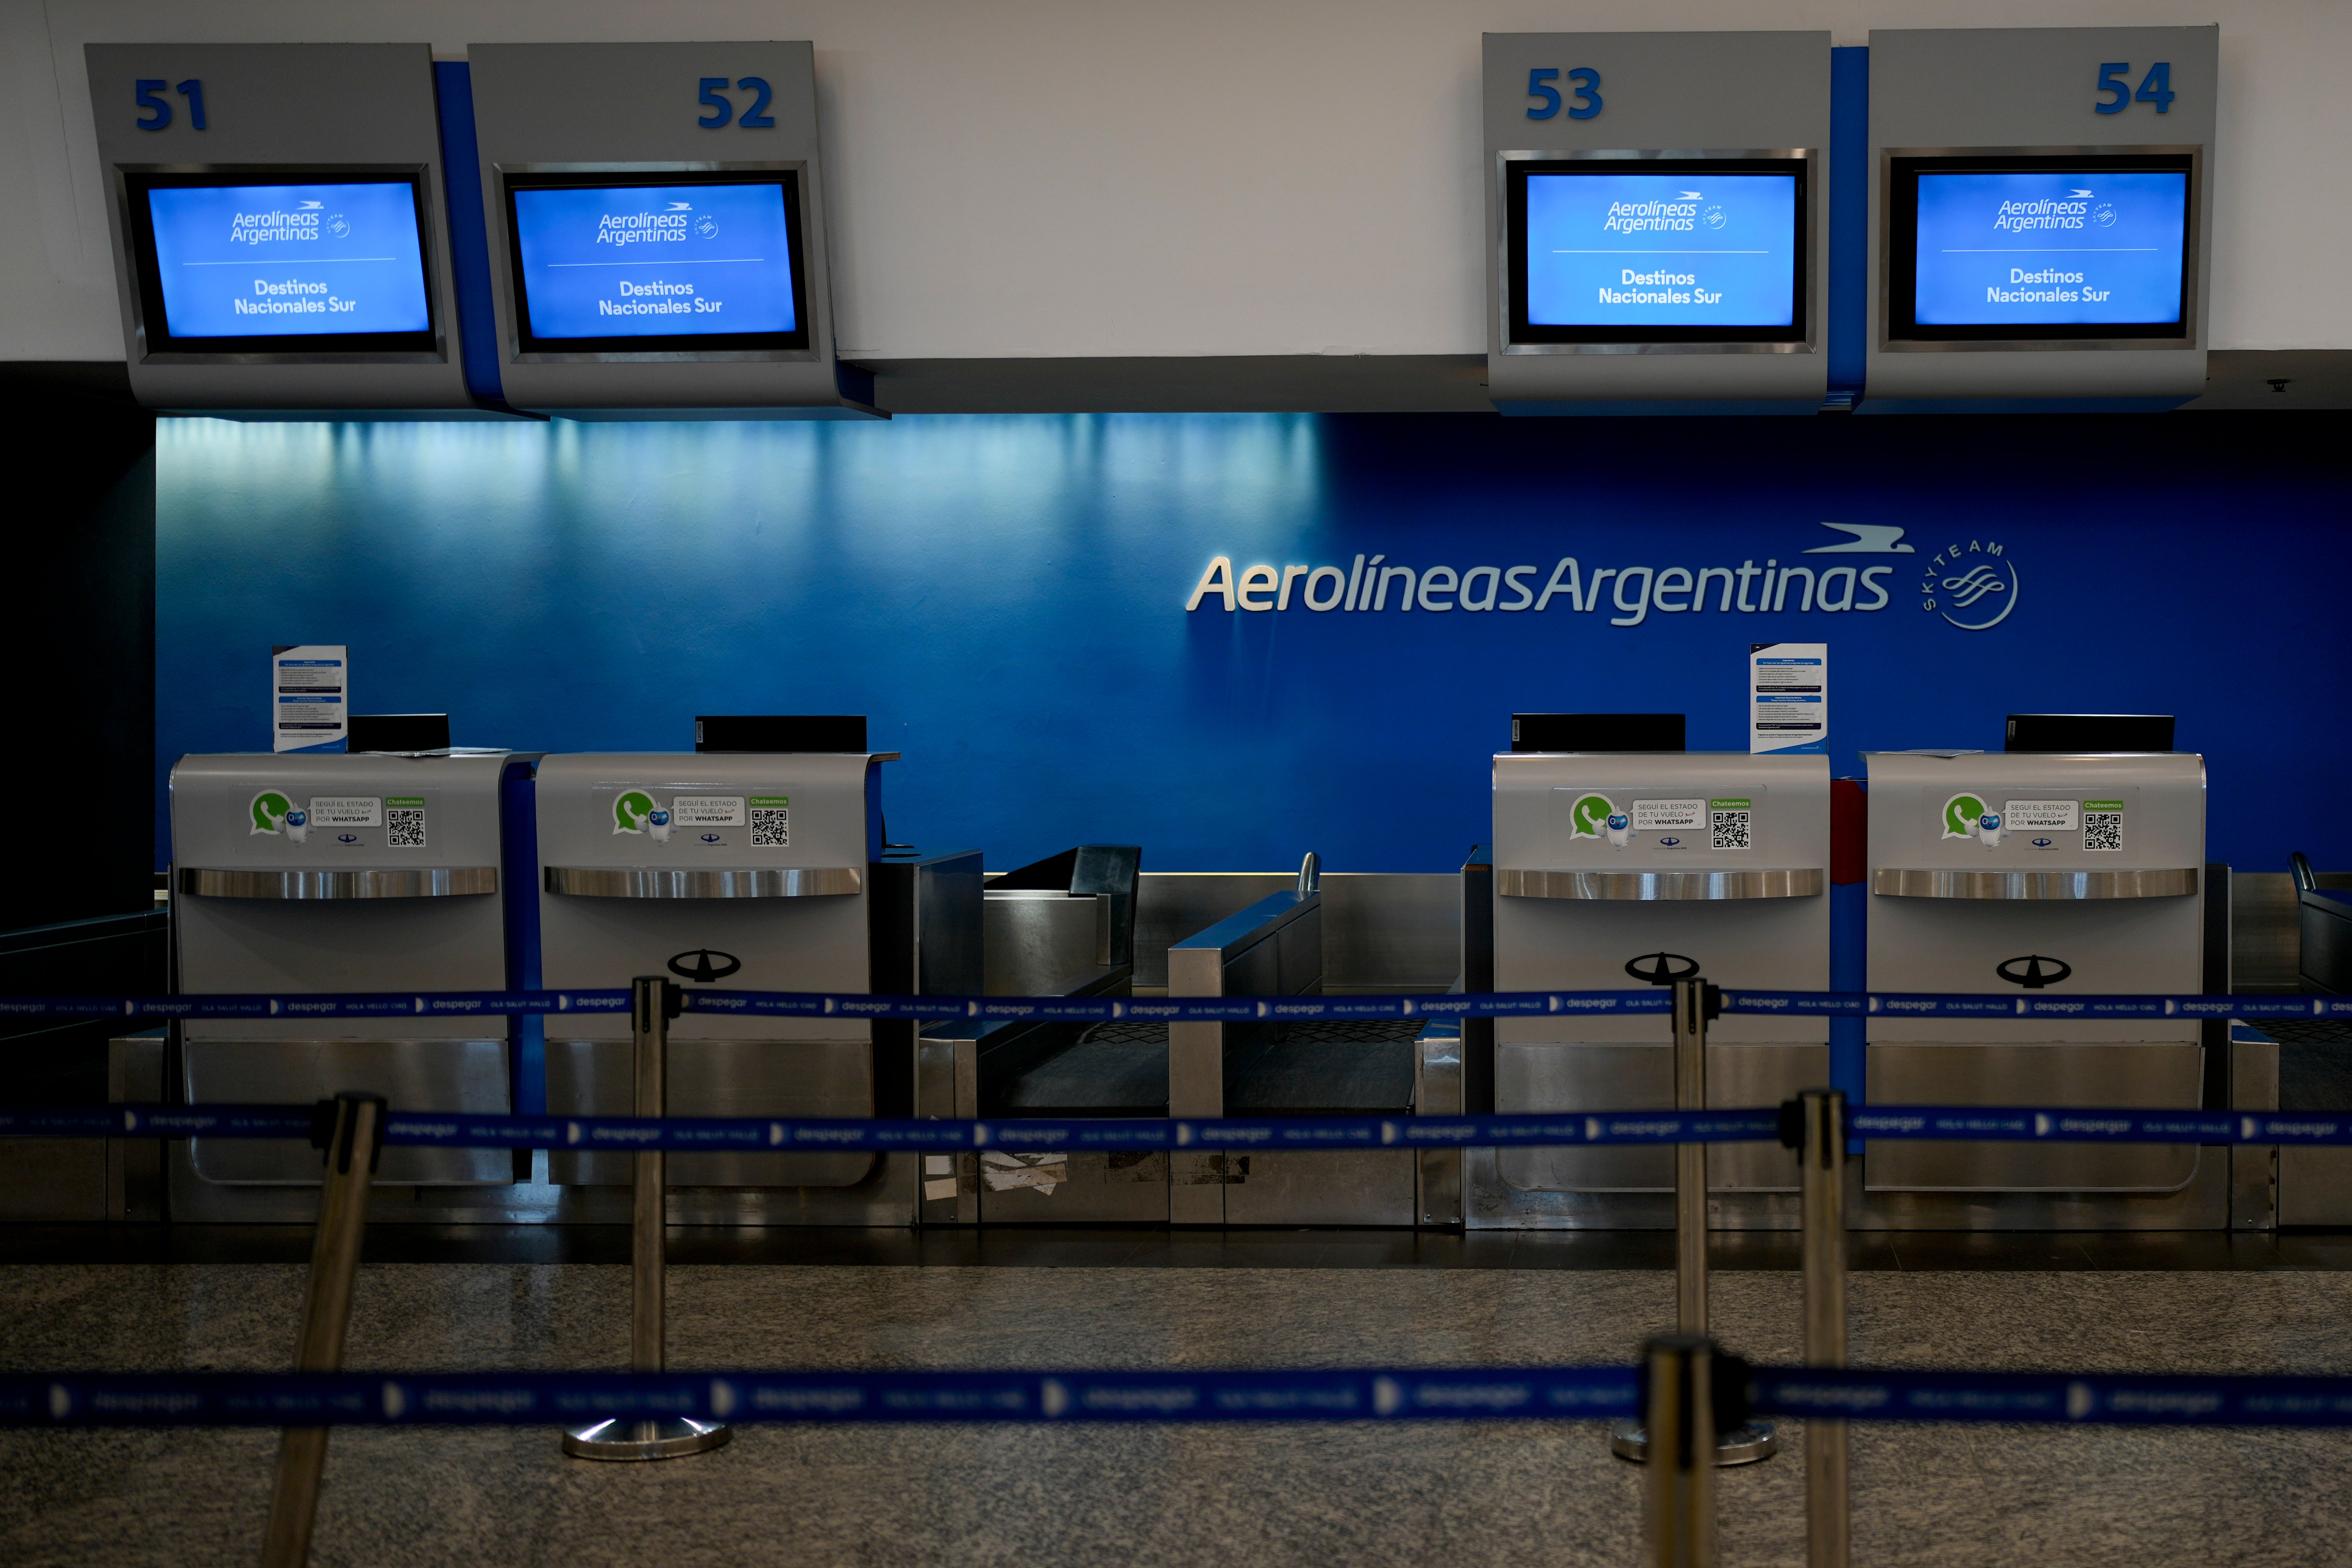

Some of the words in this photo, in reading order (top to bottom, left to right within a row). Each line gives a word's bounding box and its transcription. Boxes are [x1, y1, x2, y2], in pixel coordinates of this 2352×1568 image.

[1527, 67, 1603, 119] 53
[2095, 63, 2175, 114] 54
[136, 79, 206, 130] 51
[698, 77, 774, 128] 52
[1608, 201, 1697, 216] Aerolíneas
[1703, 205, 1721, 225] SKYTEAM
[1998, 199, 2087, 215] Aerolíneas
[2093, 203, 2112, 223] SKYTEAM
[232, 210, 319, 227] Aerolíneas
[326, 214, 343, 233] SKYTEAM
[599, 212, 687, 229] Aerolíneas
[695, 215, 711, 235] SKYTEAM
[1604, 216, 1694, 234] Argentinas
[1993, 215, 2084, 233] Argentinas
[230, 226, 318, 245] Argentinas
[597, 228, 686, 246] Argentinas
[1622, 270, 1695, 285] Destinos
[2010, 268, 2084, 284] Destinos
[255, 279, 327, 295] Destinos
[620, 280, 694, 296] Destinos
[1987, 287, 2078, 302] Nacionales
[2082, 286, 2110, 302] Sur
[1599, 288, 1690, 304] Nacionales
[1694, 288, 1722, 304] Sur
[234, 297, 326, 314] Nacionales
[329, 296, 356, 312] Sur
[599, 299, 691, 316] Nacionales
[695, 297, 722, 313] Sur
[1921, 540, 2003, 612] SKYTEAM
[143, 1003, 192, 1013] despegar
[288, 1002, 336, 1012] despegar
[432, 1000, 482, 1010] despegar
[576, 998, 625, 1007] despegar
[698, 997, 747, 1008] despegar
[842, 1002, 891, 1013] despegar
[985, 1004, 1035, 1015] despegar
[1275, 1005, 1324, 1015] despegar
[1421, 1002, 1471, 1012] despegar
[1567, 998, 1617, 1009] despegar
[1738, 997, 1789, 1009] despegar
[1886, 1000, 1937, 1011] despegar
[2034, 1002, 2085, 1012] despegar
[2182, 1002, 2234, 1013] despegar
[1131, 1006, 1180, 1016] despegar
[1853, 1115, 1926, 1132] despegar
[2059, 1118, 2132, 1134] despegar
